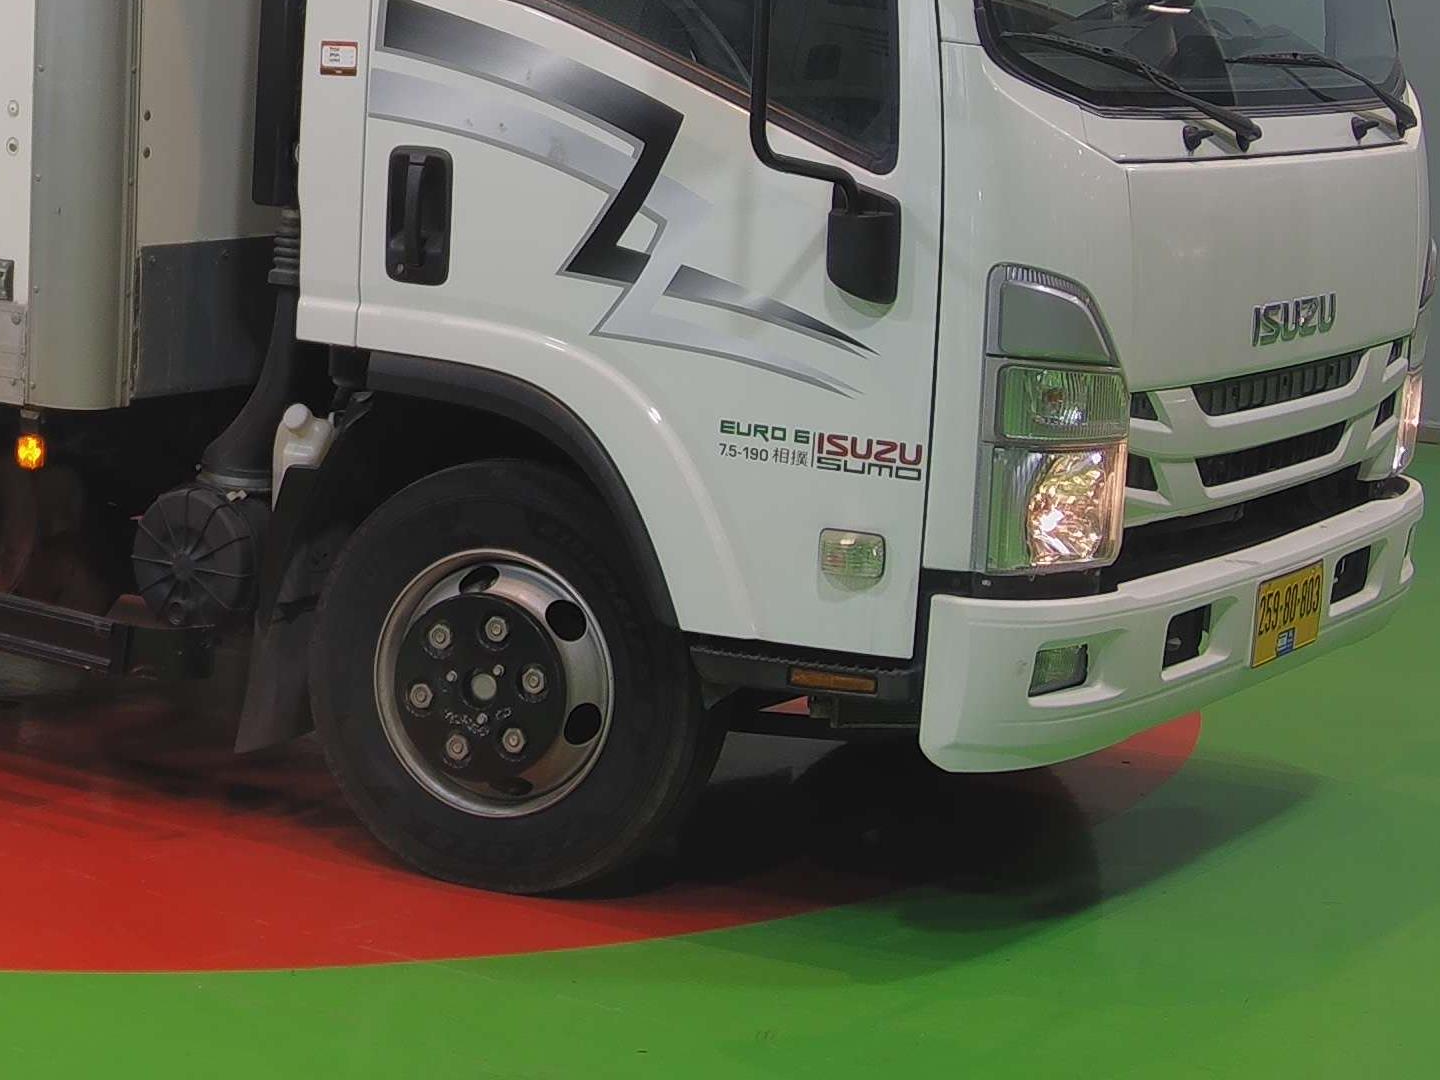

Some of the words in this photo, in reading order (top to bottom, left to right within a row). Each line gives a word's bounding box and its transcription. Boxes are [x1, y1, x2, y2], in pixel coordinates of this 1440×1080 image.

[1251, 291, 1336, 347] ISUZU
[720, 419, 786, 442] EURO
[794, 429, 810, 445] 6
[719, 443, 769, 462] 7.5-190
[817, 432, 923, 466] ISUZU
[816, 456, 922, 481] SUMO
